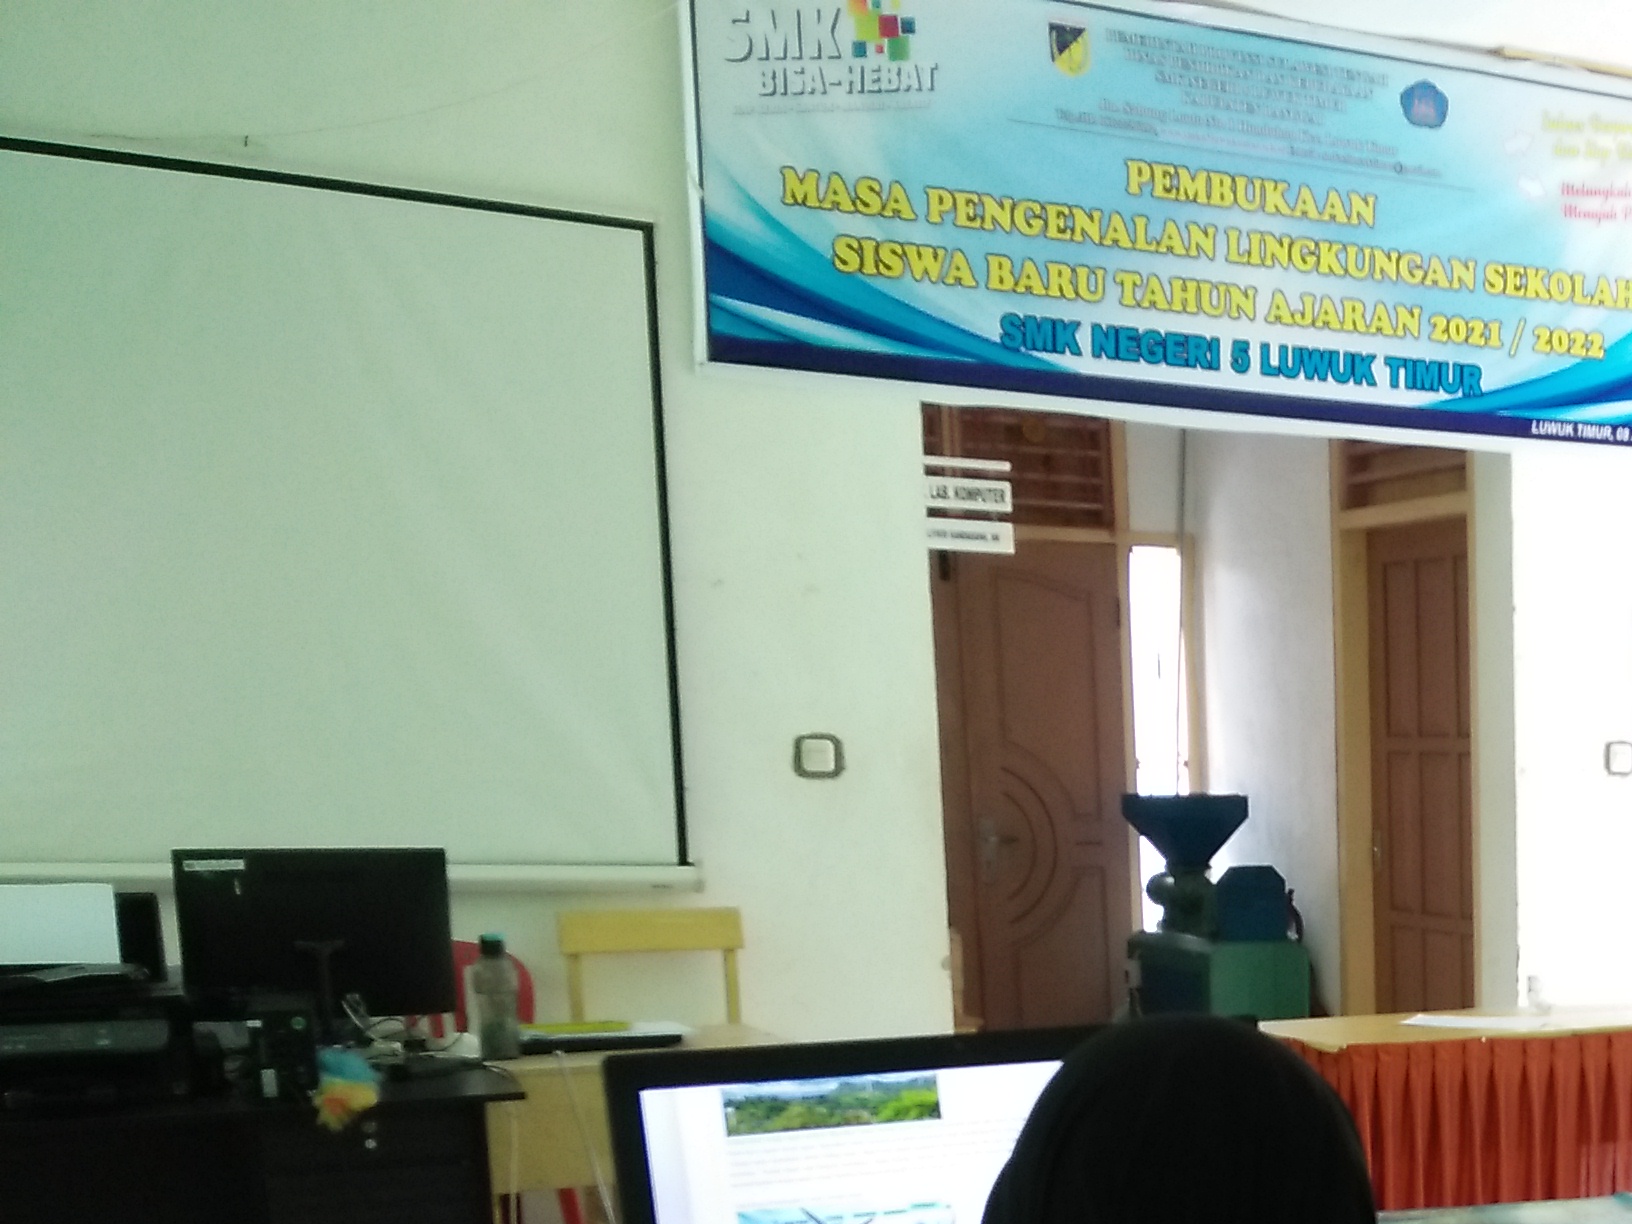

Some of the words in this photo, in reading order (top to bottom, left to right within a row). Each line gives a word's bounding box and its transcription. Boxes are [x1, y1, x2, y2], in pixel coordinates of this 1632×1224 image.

[722, 7, 842, 63] SMK
[781, 166, 916, 221] MASA
[925, 186, 1216, 261] PENGENALAN
[1226, 228, 1477, 292] LINGKUNGAN
[1125, 159, 1377, 228] PEMBUKAAN
[832, 235, 976, 289] SISWA
[987, 255, 1106, 302] BARU
[1115, 271, 1257, 322] TAHUN
[1266, 290, 1421, 338] AJARAN
[1429, 314, 1503, 348] 2021
[1509, 318, 1527, 357] /
[1533, 327, 1605, 359] 2022
[1000, 313, 1081, 356] SMK
[1092, 325, 1220, 371] NEGERI
[1230, 342, 1251, 372] 5
[1260, 344, 1376, 386] LUWUK
[1385, 356, 1484, 396] TIMUR
[1531, 419, 1575, 437] LUWUK
